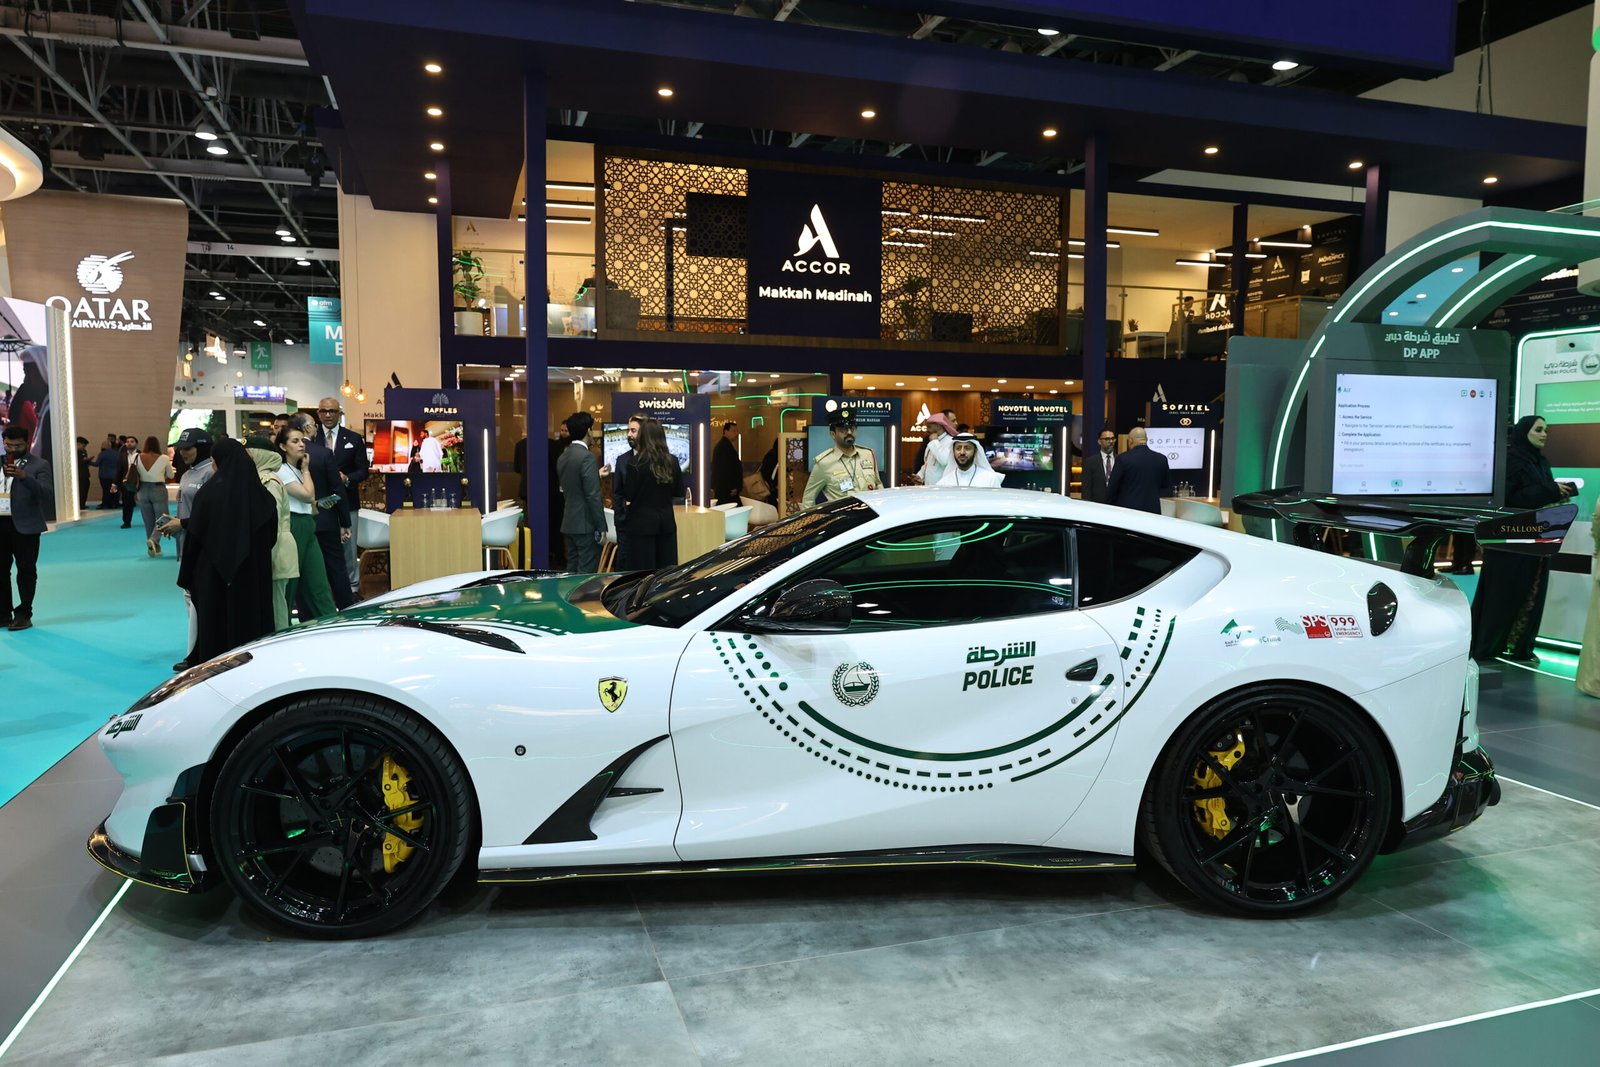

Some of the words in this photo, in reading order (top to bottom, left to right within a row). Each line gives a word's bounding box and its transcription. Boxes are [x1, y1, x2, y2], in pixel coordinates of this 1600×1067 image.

[782, 259, 851, 275] ACCOR
[759, 286, 812, 300] Makkah
[815, 288, 873, 303] Madinah
[71, 319, 117, 329] AIRWAYS
[1403, 329, 1431, 345] شرطة
[1403, 347, 1419, 359] DP
[1419, 348, 1441, 359] APP
[639, 395, 686, 410] swissôtel
[840, 400, 892, 411] pullman
[423, 407, 458, 415] RAFFLES
[1500, 525, 1543, 533] STALLONE
[1302, 615, 1328, 628] SPS
[1330, 616, 1356, 627] 999
[966, 641, 1036, 667] الشرطة
[962, 665, 1035, 692] POLICE
